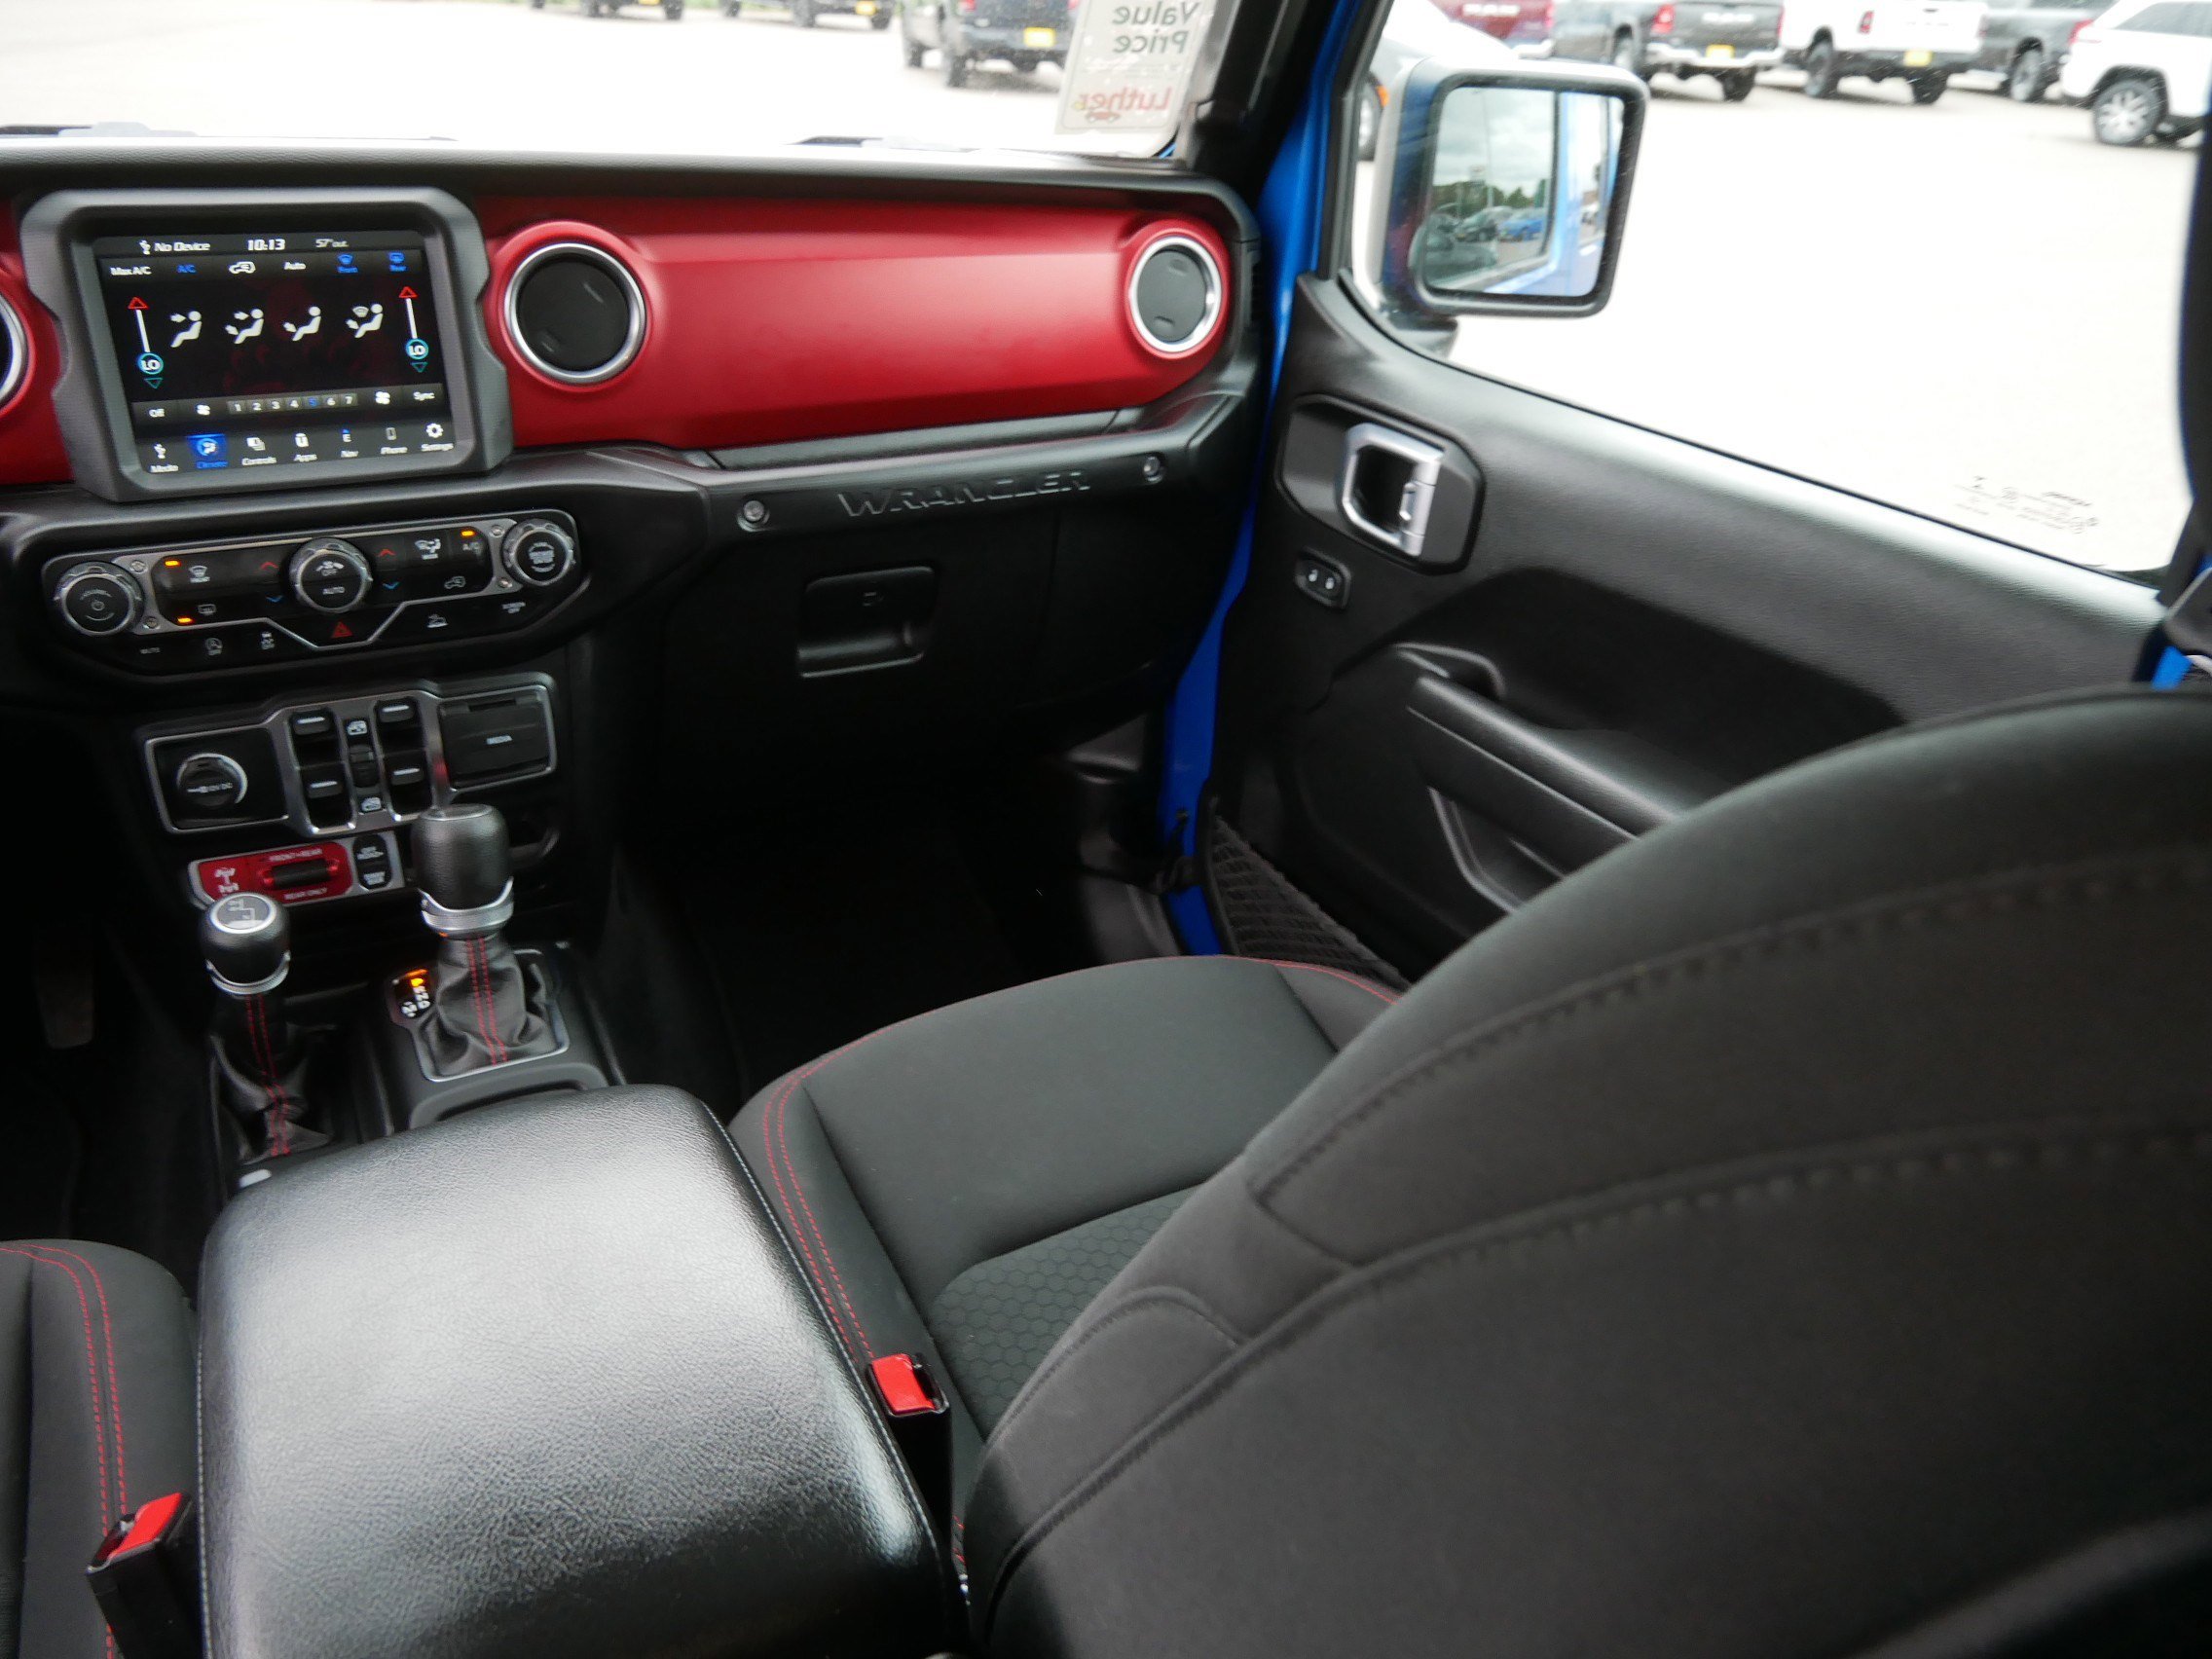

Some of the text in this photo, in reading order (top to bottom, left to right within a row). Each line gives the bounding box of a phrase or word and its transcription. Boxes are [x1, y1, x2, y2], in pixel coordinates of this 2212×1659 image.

[154, 241, 210, 252] No Device
[247, 239, 286, 251] 10:13
[409, 345, 426, 355] LO
[141, 359, 161, 370] LO
[289, 399, 299, 408] 4
[309, 398, 318, 407] 5
[326, 397, 336, 406] 6
[345, 395, 353, 404] 7
[234, 403, 241, 412] 1
[252, 402, 262, 411] 2
[272, 400, 280, 410] 3
[836, 471, 1091, 516] WRANGLER
